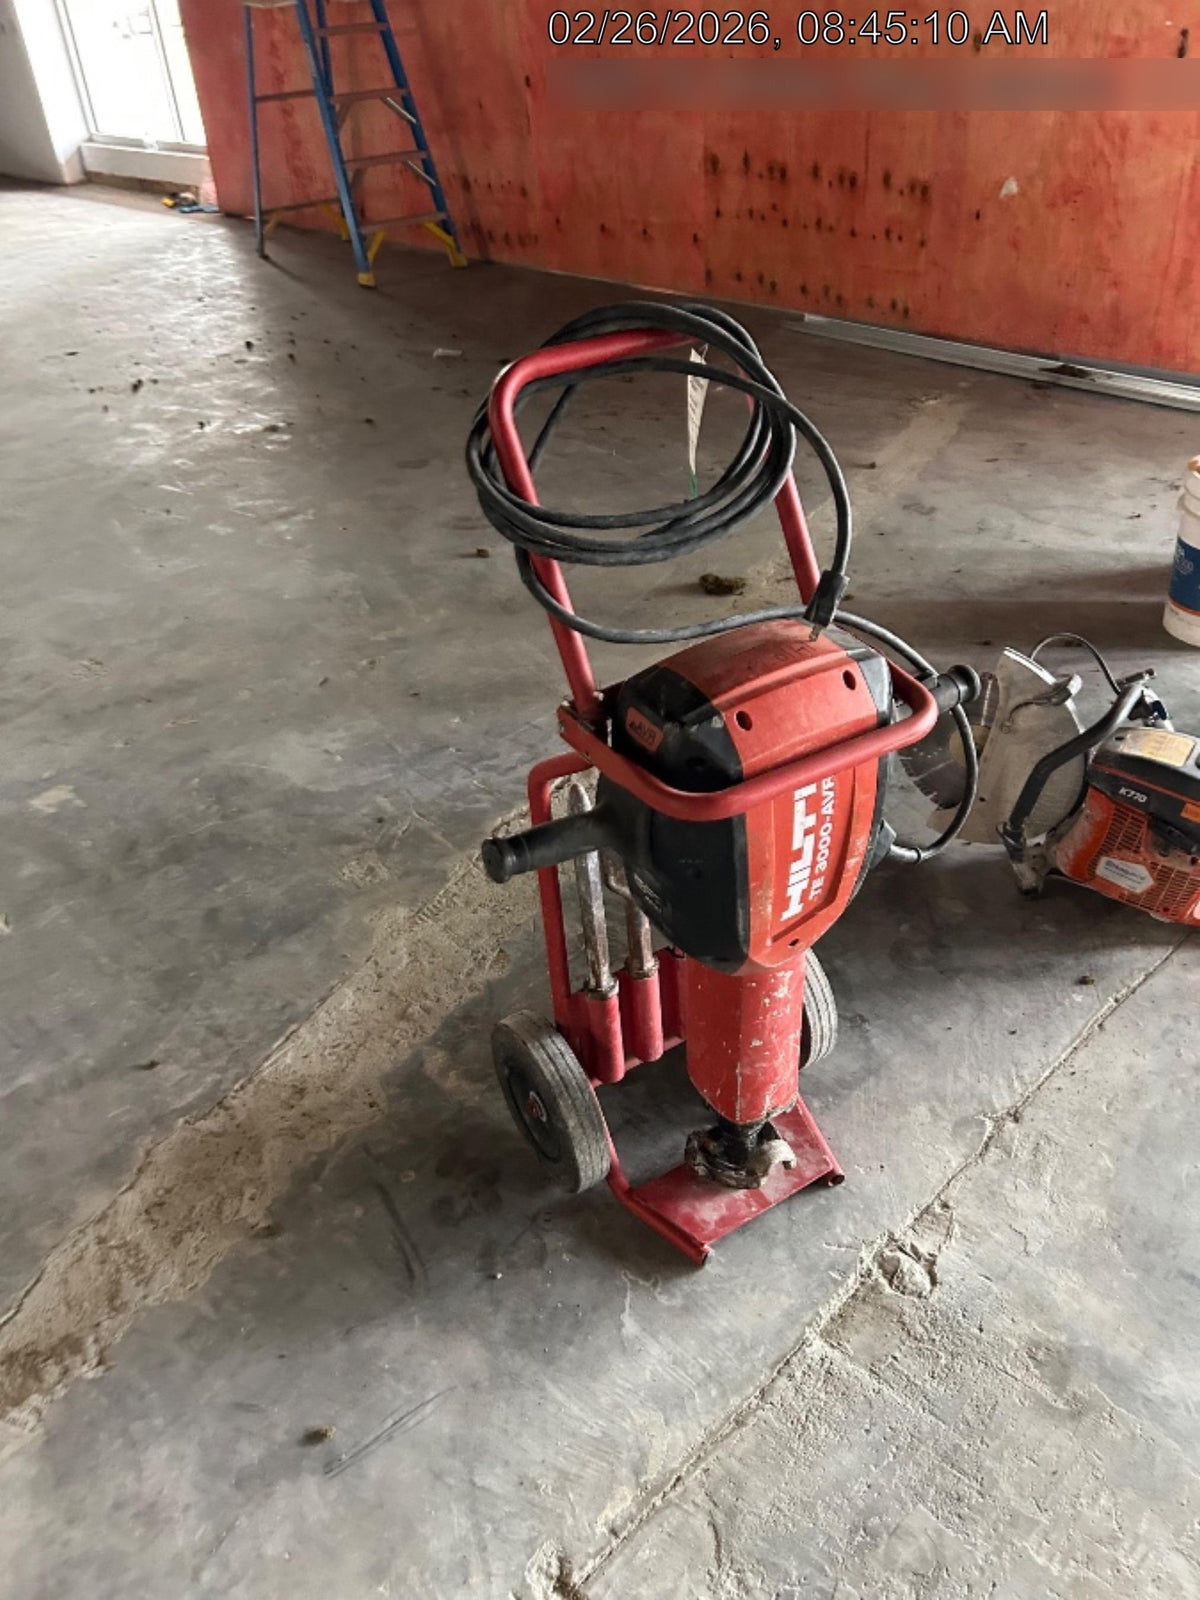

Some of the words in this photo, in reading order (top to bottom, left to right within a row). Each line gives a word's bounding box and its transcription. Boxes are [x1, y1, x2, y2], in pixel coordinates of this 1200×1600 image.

[815, 776, 835, 874] 3000-AVR
[1118, 786, 1148, 803] K770
[780, 783, 818, 922] HILTI
[808, 876, 825, 901] TE
